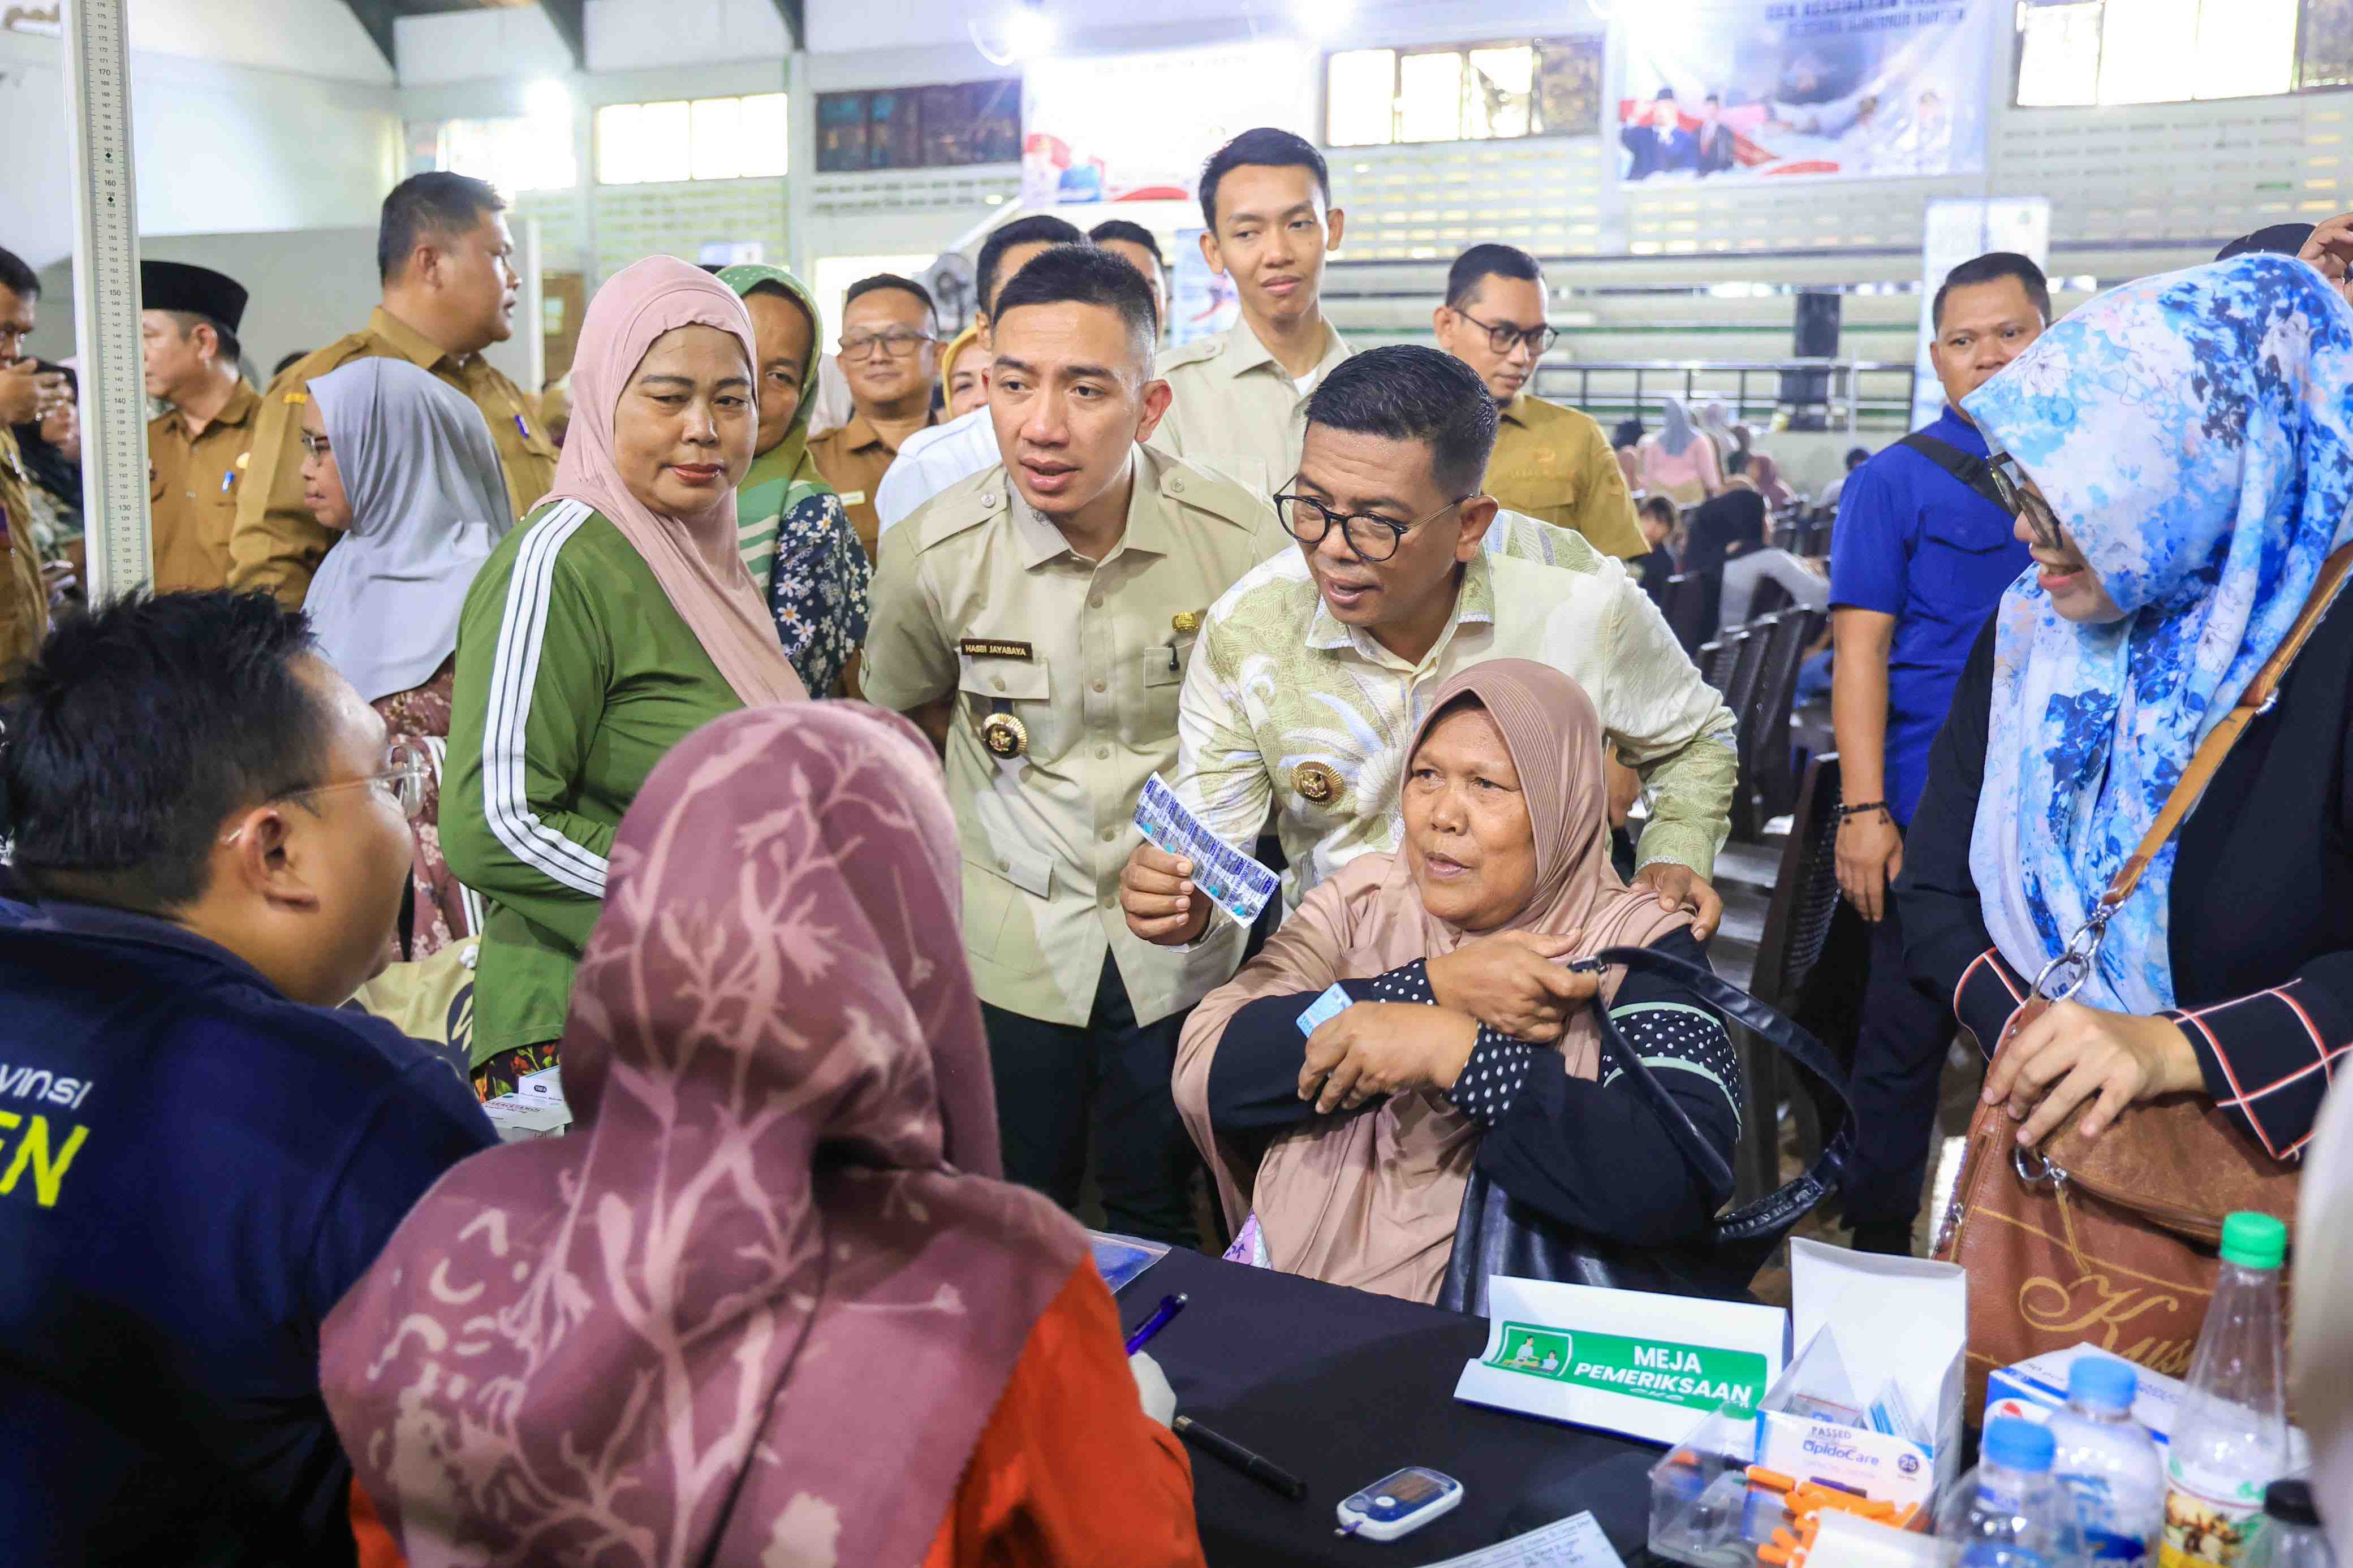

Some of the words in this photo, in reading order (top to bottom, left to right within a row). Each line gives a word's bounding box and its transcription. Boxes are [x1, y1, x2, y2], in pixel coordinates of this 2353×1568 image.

[989, 645, 1026, 656] JAYABAYA
[1634, 1345, 1702, 1374] MEJA
[1574, 1362, 1752, 1403] PEMERIKSAAN
[1812, 1427, 1851, 1439] PASSED
